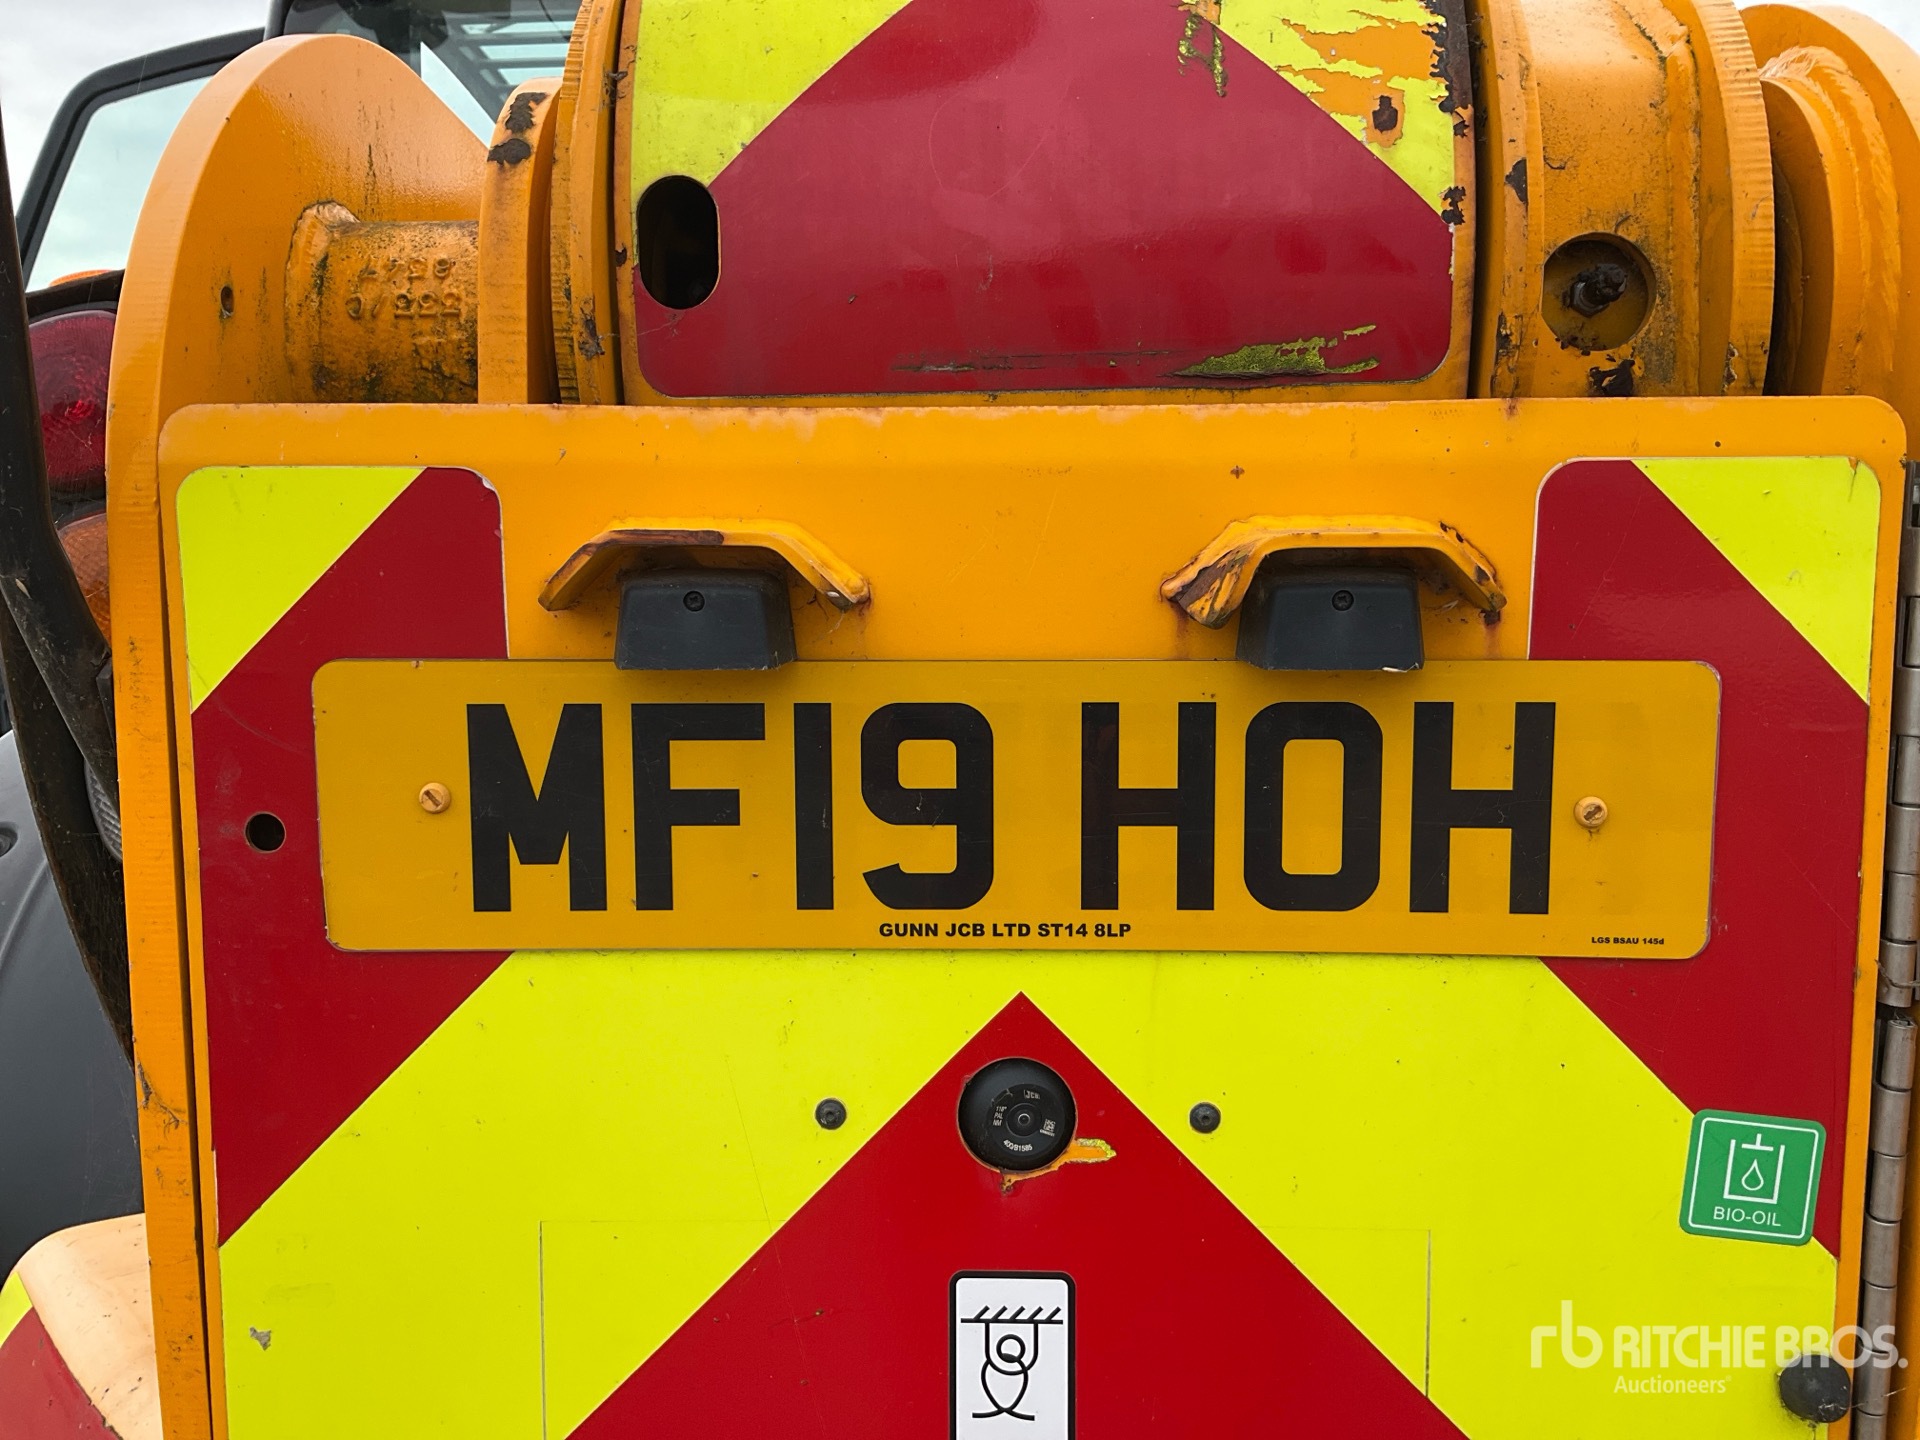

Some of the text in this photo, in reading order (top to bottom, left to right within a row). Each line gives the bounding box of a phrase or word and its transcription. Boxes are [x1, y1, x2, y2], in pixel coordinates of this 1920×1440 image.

[466, 701, 1557, 914] MF19 HOH
[879, 922, 1132, 937] GUNN JCB LTD ST14 8LP
[1591, 936, 1611, 944] LGS
[1613, 937, 1640, 945] BSAU
[1713, 1206, 1782, 1227] BIO-OIL
